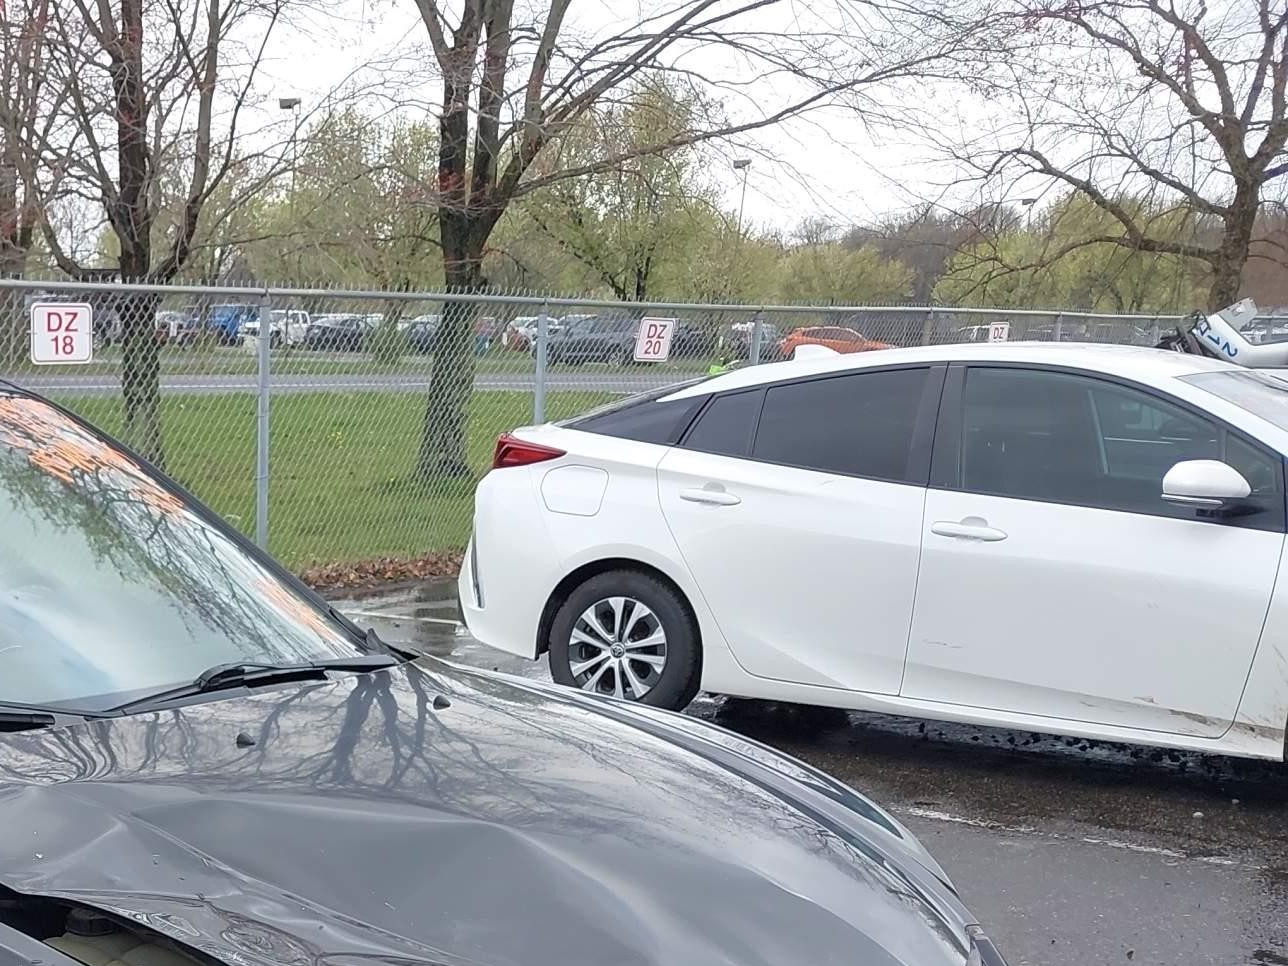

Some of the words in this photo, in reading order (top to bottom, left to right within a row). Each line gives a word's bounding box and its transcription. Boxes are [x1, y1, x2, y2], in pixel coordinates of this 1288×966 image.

[47, 311, 78, 332] DZ
[646, 323, 667, 339] DZ
[51, 335, 74, 355] 18
[644, 340, 662, 355] 20
